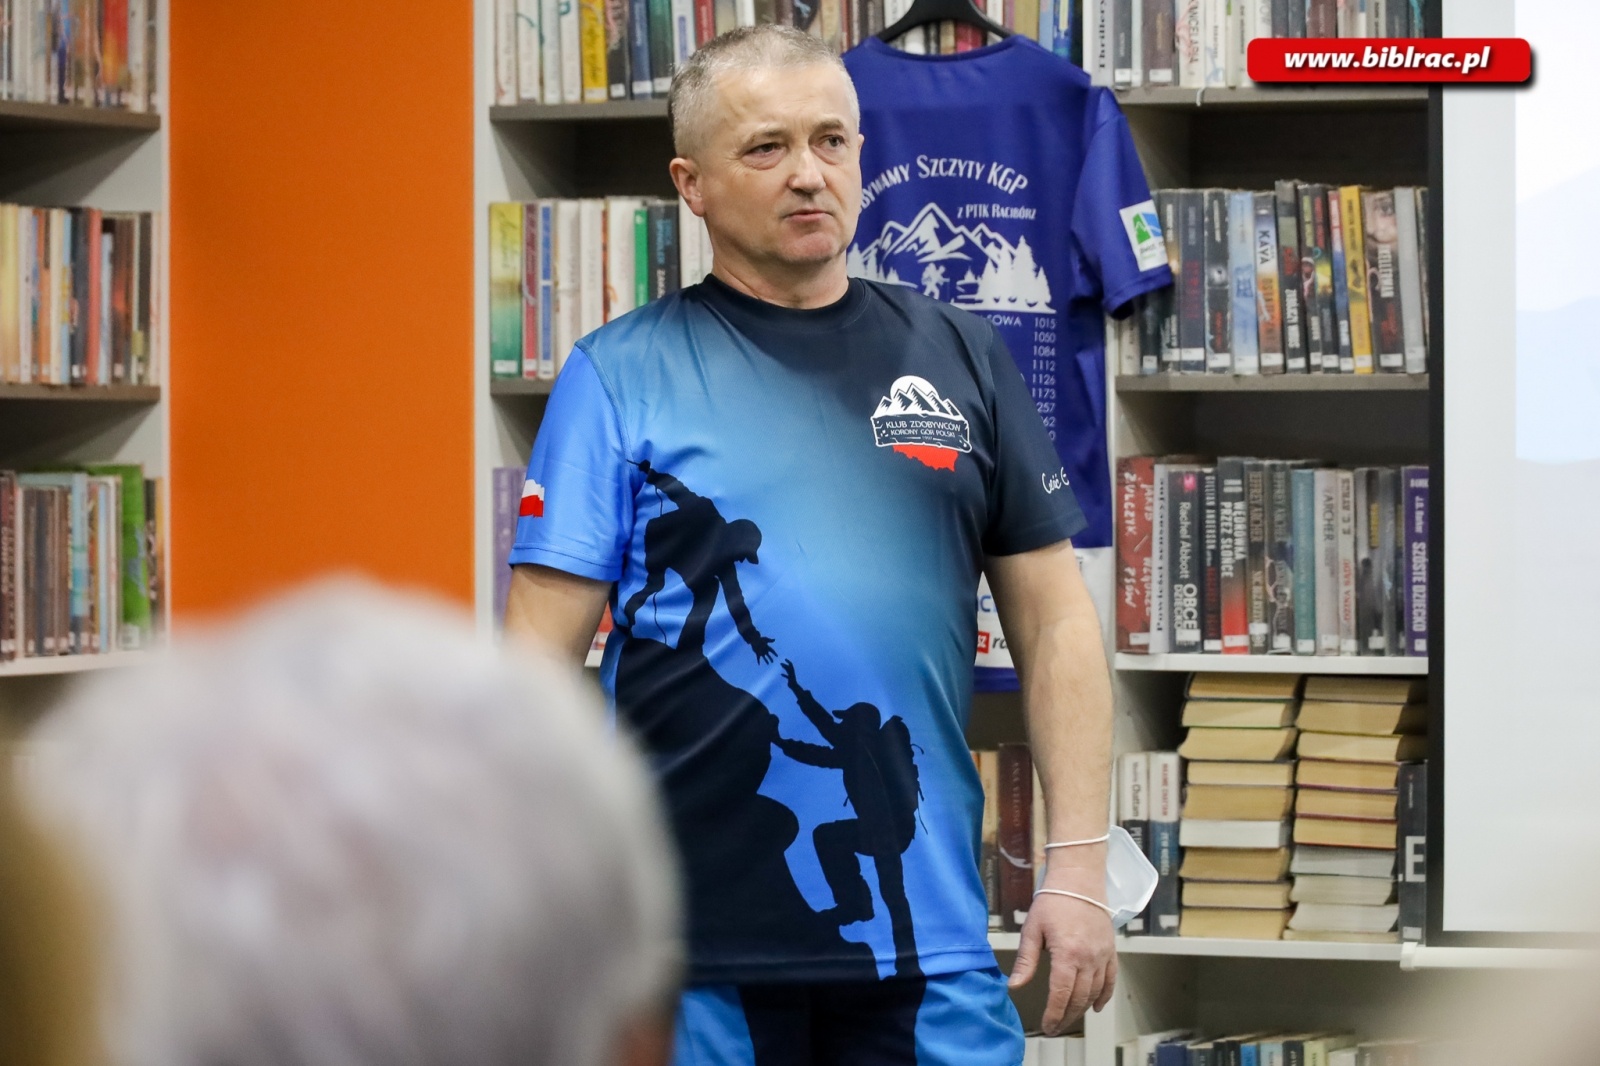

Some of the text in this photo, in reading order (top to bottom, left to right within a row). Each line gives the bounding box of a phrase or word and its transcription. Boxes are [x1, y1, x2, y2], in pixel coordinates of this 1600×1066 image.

[916, 154, 985, 180] SZCZYTY
[987, 161, 1029, 195] KGP
[1258, 230, 1271, 265] KAVA
[1034, 317, 1056, 329] 1015
[1032, 359, 1056, 372] 1112
[1032, 373, 1056, 386] 1126
[1032, 388, 1056, 399] 1173
[1036, 402, 1056, 413] 257
[885, 420, 961, 432] KLUB ZDOBYWCÓW
[920, 428, 935, 436] GÓR
[936, 430, 956, 438] POLSKI
[1042, 416, 1056, 428] 62
[1220, 501, 1233, 534] PRZEZ
[1249, 507, 1264, 542] ARCHER
[1323, 494, 1335, 542] ARCHER
[1179, 502, 1192, 579] Rachel Abbott
[1412, 541, 1428, 632] SZÓSTE DZIECKO
[1174, 584, 1184, 630] DZIECKO
[1183, 583, 1198, 629] OBCE
[1131, 784, 1142, 817] Chattam
